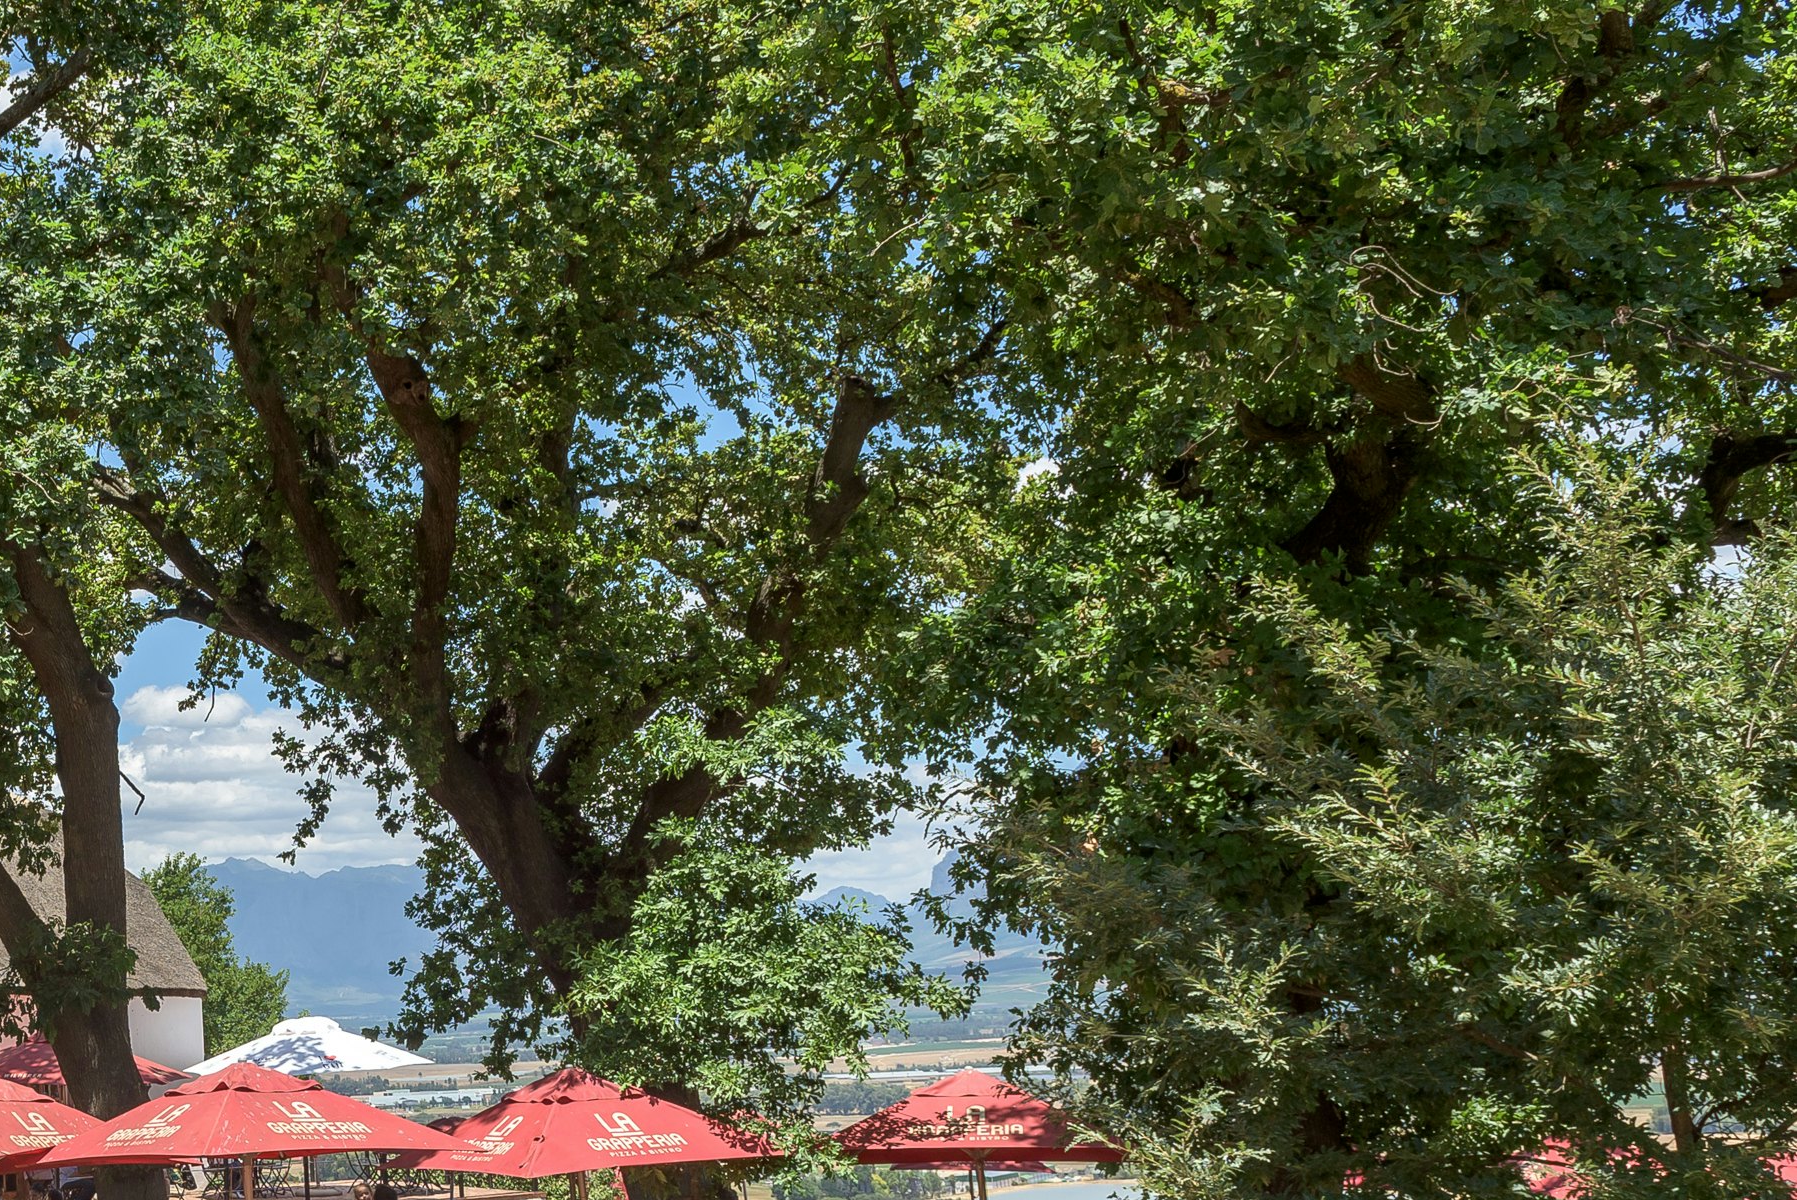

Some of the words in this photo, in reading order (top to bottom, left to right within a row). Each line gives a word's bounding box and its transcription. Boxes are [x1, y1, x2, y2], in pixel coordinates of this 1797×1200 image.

[148, 1103, 191, 1123] LA
[272, 1101, 322, 1118] LA
[11, 1111, 56, 1131] LA
[266, 1121, 373, 1134] GRAPPERIA
[488, 1115, 524, 1137] LA
[593, 1112, 641, 1133] LA
[106, 1125, 182, 1141] GRAPPERIA
[586, 1133, 688, 1151] GRAPPERIA
[649, 1147, 682, 1155] BISTRO
